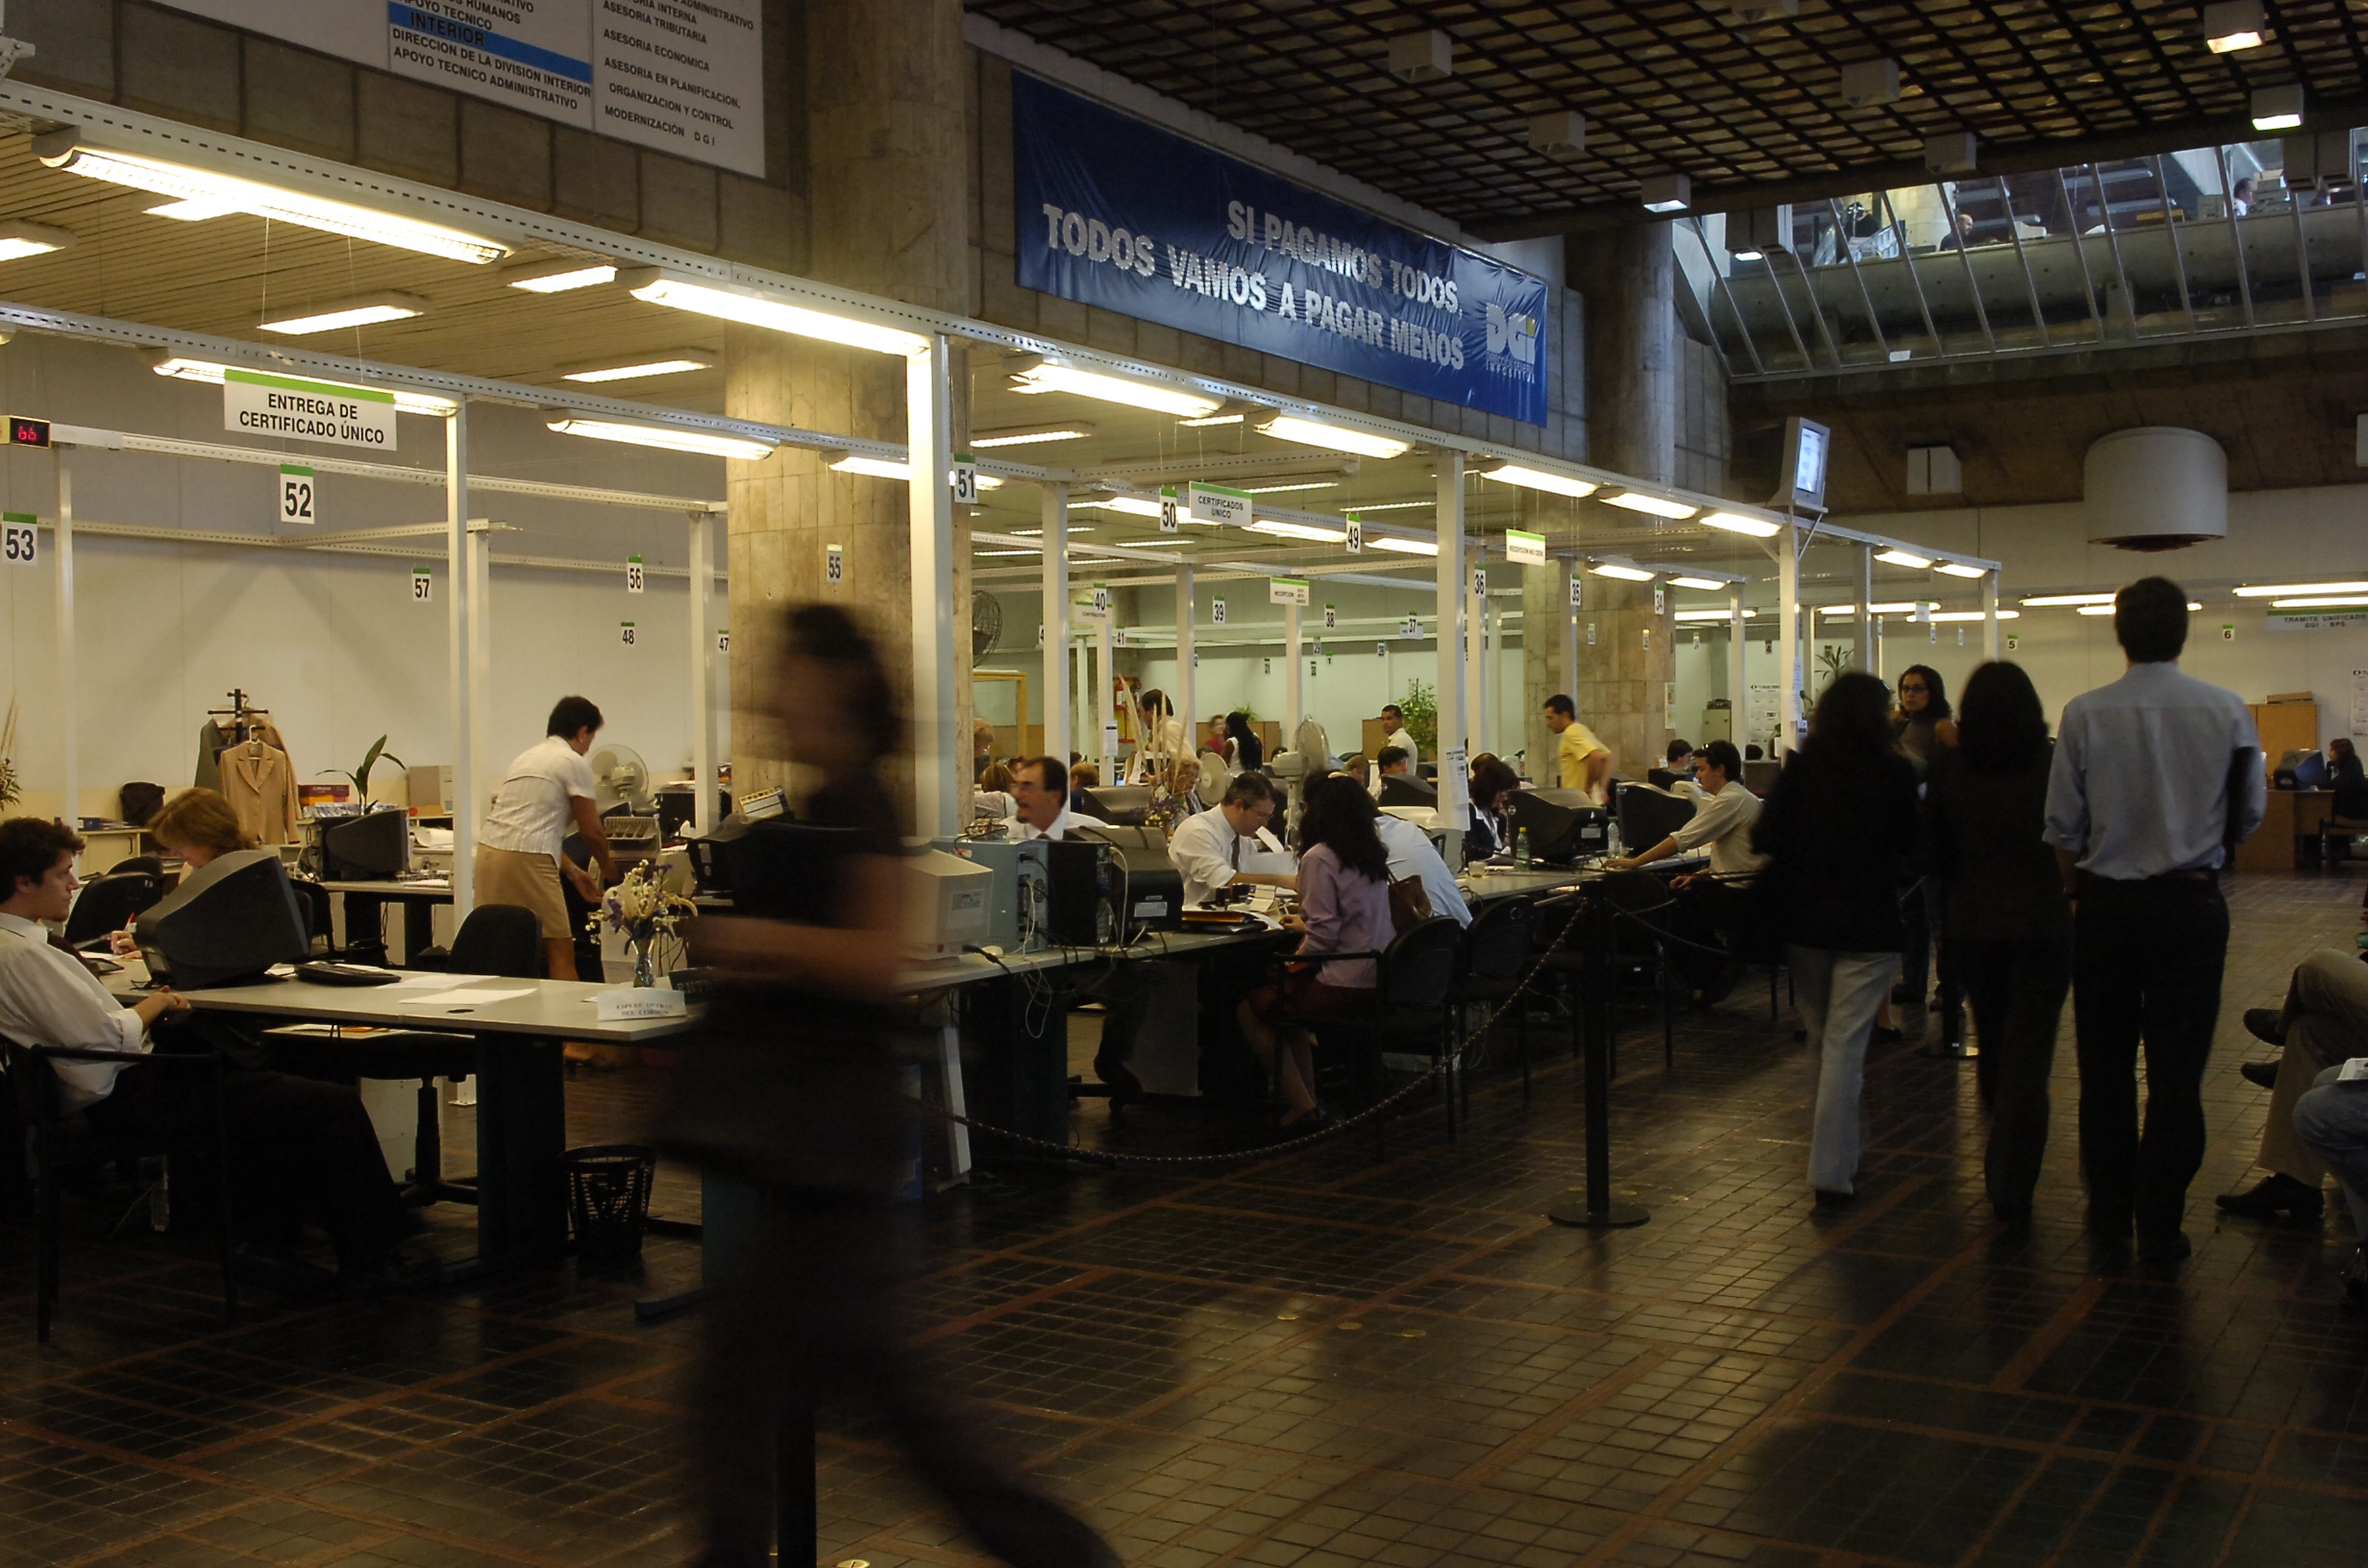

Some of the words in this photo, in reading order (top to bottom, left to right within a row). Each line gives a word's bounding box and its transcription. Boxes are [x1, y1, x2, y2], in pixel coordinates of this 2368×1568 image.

[443, 5, 492, 31] TECNICO
[466, 0, 521, 25] HUMANOS
[604, 0, 653, 25] ASESORIA
[654, 16, 707, 44] TRIBUTARIA
[657, 2, 697, 25] INTERNA
[410, 12, 485, 47] INTERIOR
[392, 28, 457, 57] DIRECCION
[460, 48, 476, 61] DE
[479, 54, 492, 68] LA
[495, 60, 541, 83] DIVISION
[544, 75, 592, 98] INTERIOR
[604, 29, 653, 53] ASESORIA
[654, 45, 710, 72] ECONOMICA
[393, 46, 434, 67] APOYO
[438, 59, 487, 83] TECNICO
[490, 75, 579, 110] ADMINISTRATIVO
[604, 57, 654, 81] ASESORIA
[655, 73, 668, 86] EN
[608, 83, 681, 113] ORGANIZACION
[683, 106, 690, 115] Y
[691, 108, 733, 130] CONTROL
[1227, 200, 1255, 245] SI
[1265, 212, 1383, 289] PAGAMOS
[1043, 204, 1155, 277] TODOS
[1167, 243, 1267, 312] VAMOS
[1278, 282, 1297, 322] A
[1305, 289, 1385, 348] PAGAR
[1391, 318, 1465, 371] MENOS
[268, 393, 335, 417] ENTREGA
[339, 404, 358, 420] DE
[239, 410, 336, 437] CERTIFICADO
[341, 420, 384, 444] ÚNICO
[958, 469, 975, 498] 51
[284, 482, 312, 518] 52
[1162, 502, 1176, 528] 50
[5, 528, 36, 562] 53
[1347, 527, 1359, 550] 49
[629, 568, 642, 589] 56
[828, 556, 841, 579] 55
[414, 577, 430, 600] 57
[1475, 574, 1484, 595] 36
[1095, 592, 1106, 611] 40
[1214, 603, 1224, 622] 39
[1325, 611, 1335, 628] 38
[2322, 613, 2367, 622] UNIFICADO
[622, 629, 635, 645] 48
[719, 637, 729, 651] 47
[2009, 640, 2015, 649] 5
[2224, 629, 2232, 640] 6
